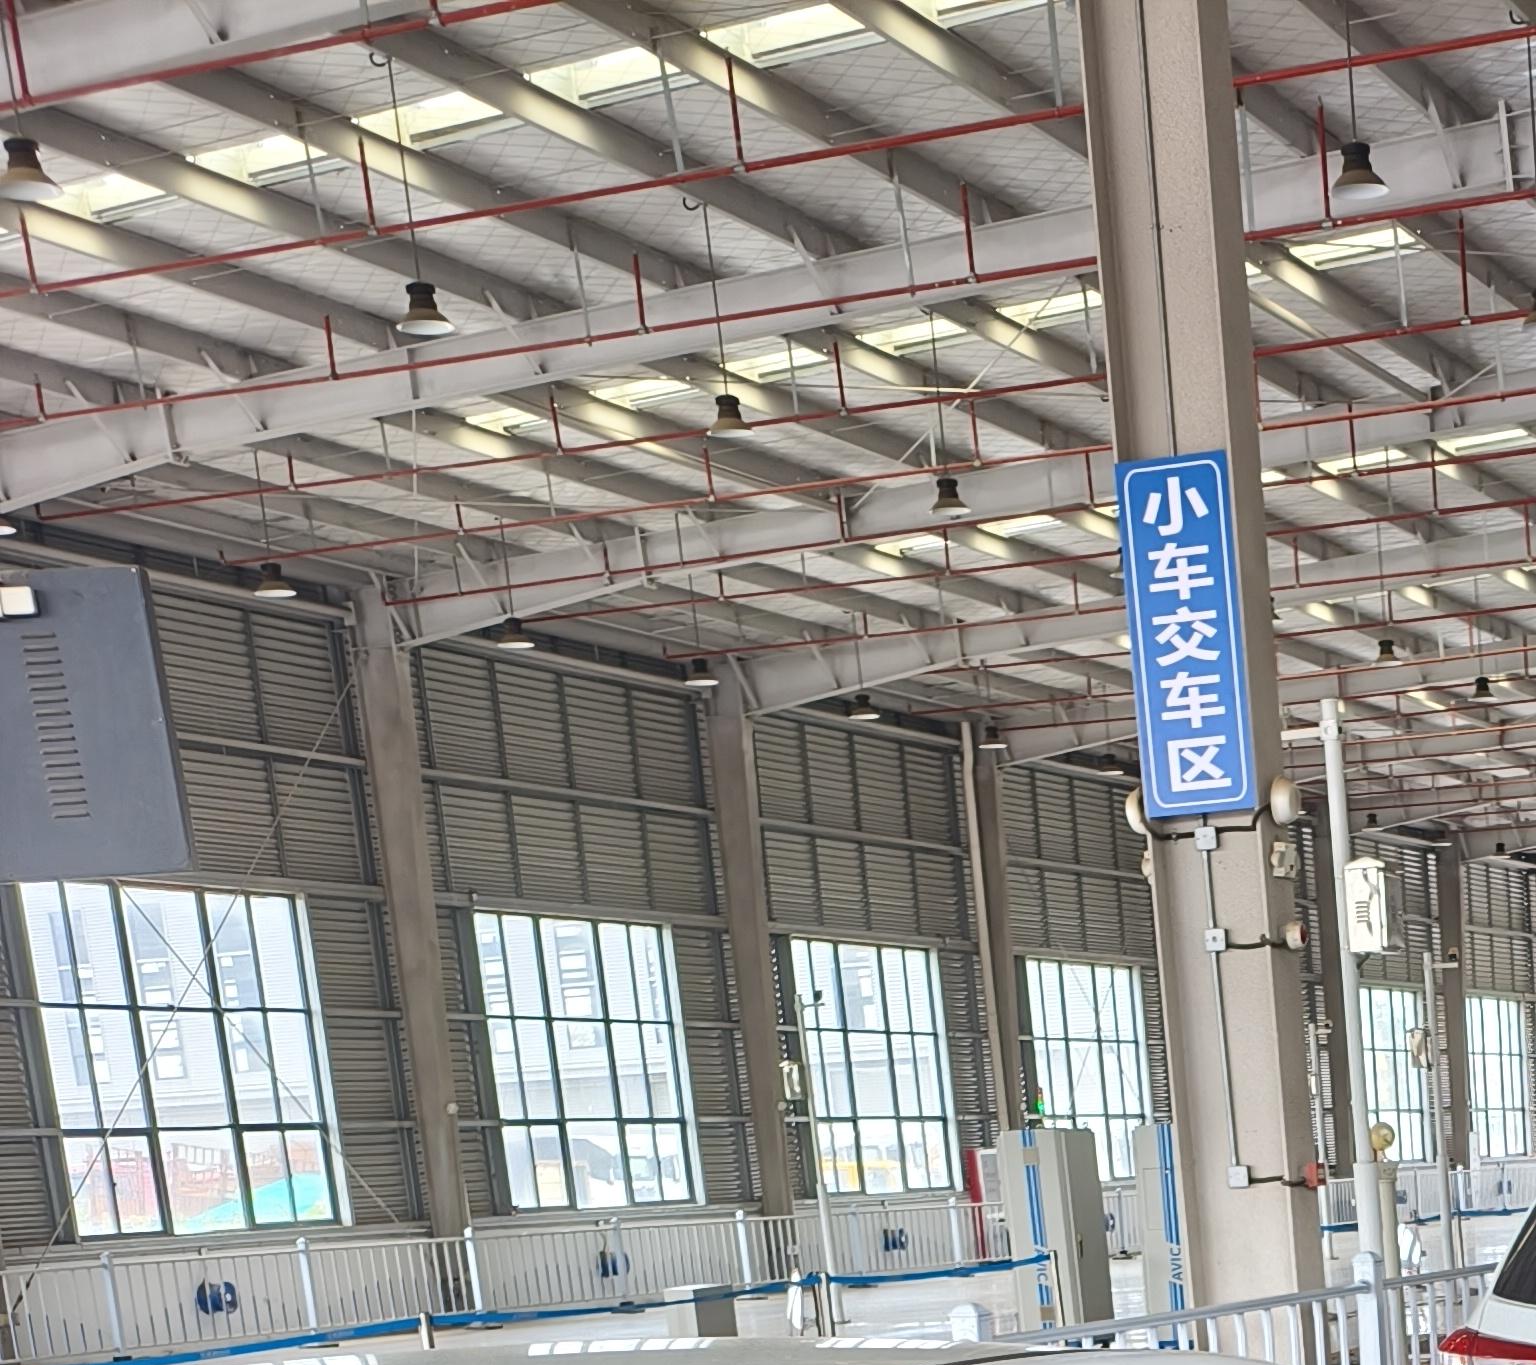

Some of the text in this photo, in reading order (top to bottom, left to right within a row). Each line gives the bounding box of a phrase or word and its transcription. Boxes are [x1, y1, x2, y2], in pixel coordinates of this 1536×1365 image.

[1142, 475, 1233, 794] 小车交车区
[1169, 1246, 1183, 1281] AVIC
